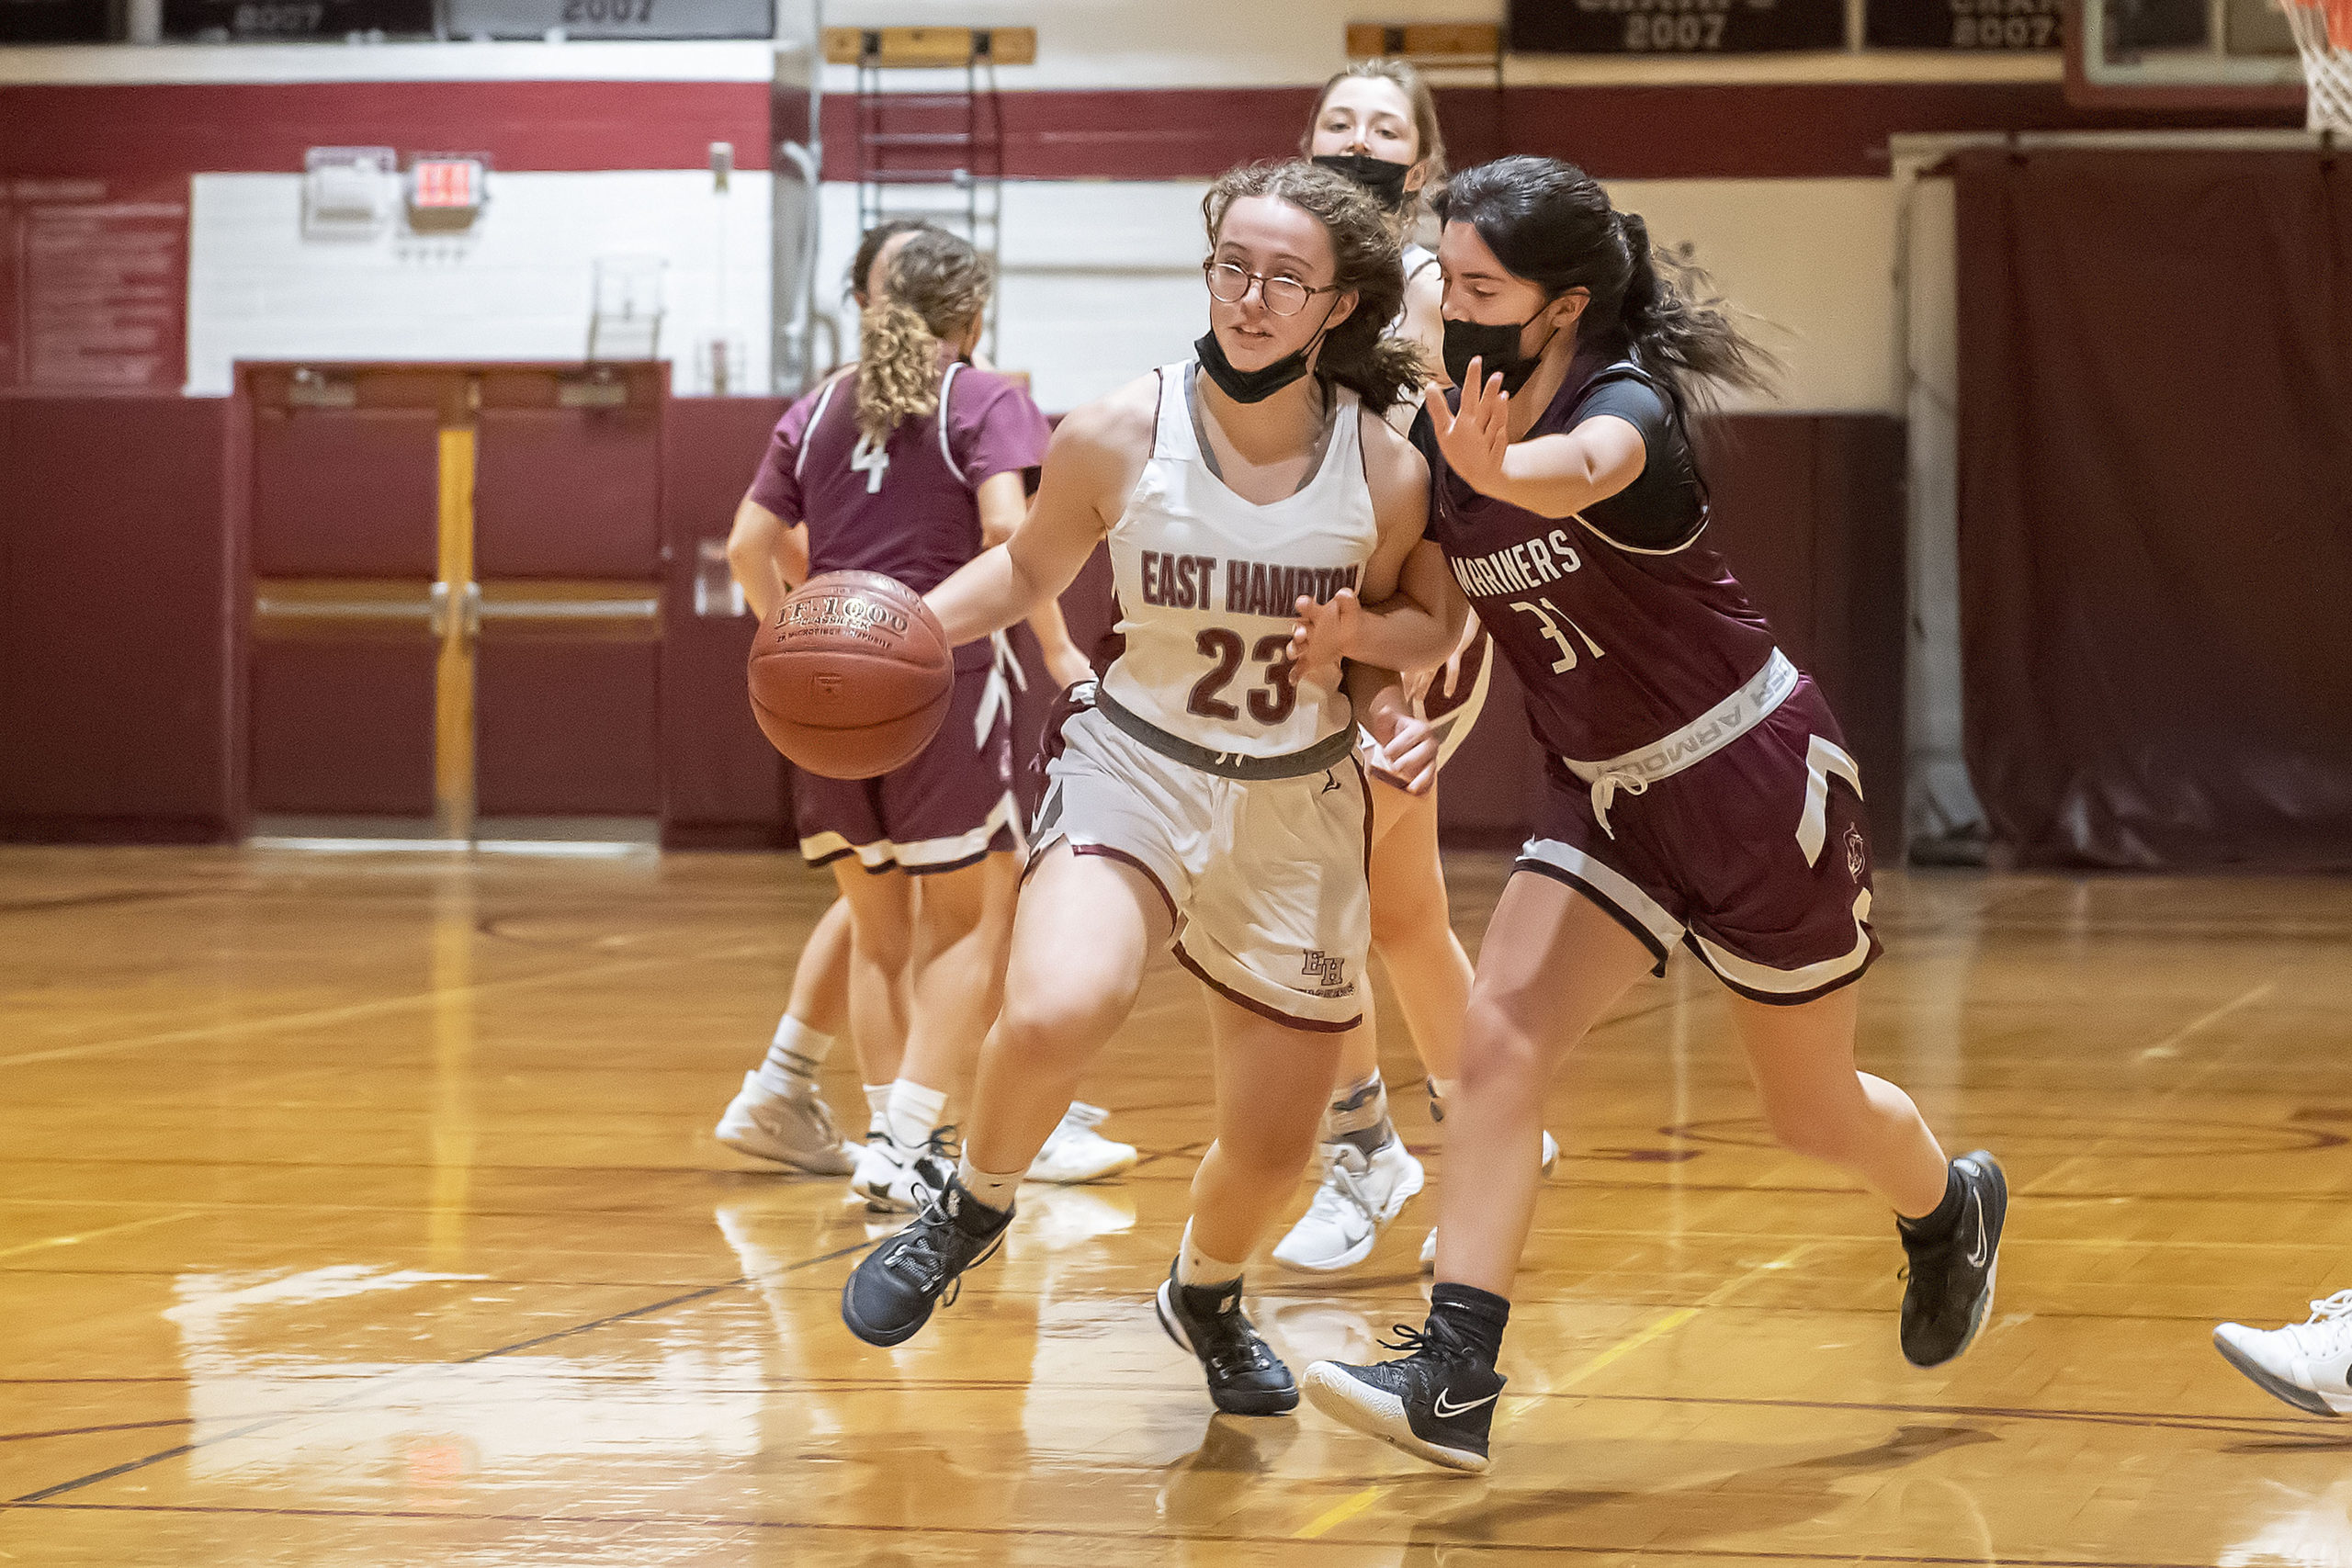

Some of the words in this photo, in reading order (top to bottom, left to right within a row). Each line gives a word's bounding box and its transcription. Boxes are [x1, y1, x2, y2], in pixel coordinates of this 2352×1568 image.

[1625, 13, 1727, 50] 2007
[851, 434, 890, 494] 4
[1139, 549, 1217, 611] EAST
[1450, 528, 1582, 599] MARINERS
[1509, 596, 1606, 676] 31
[1186, 626, 1298, 727] 23
[1301, 949, 1345, 987] EH
